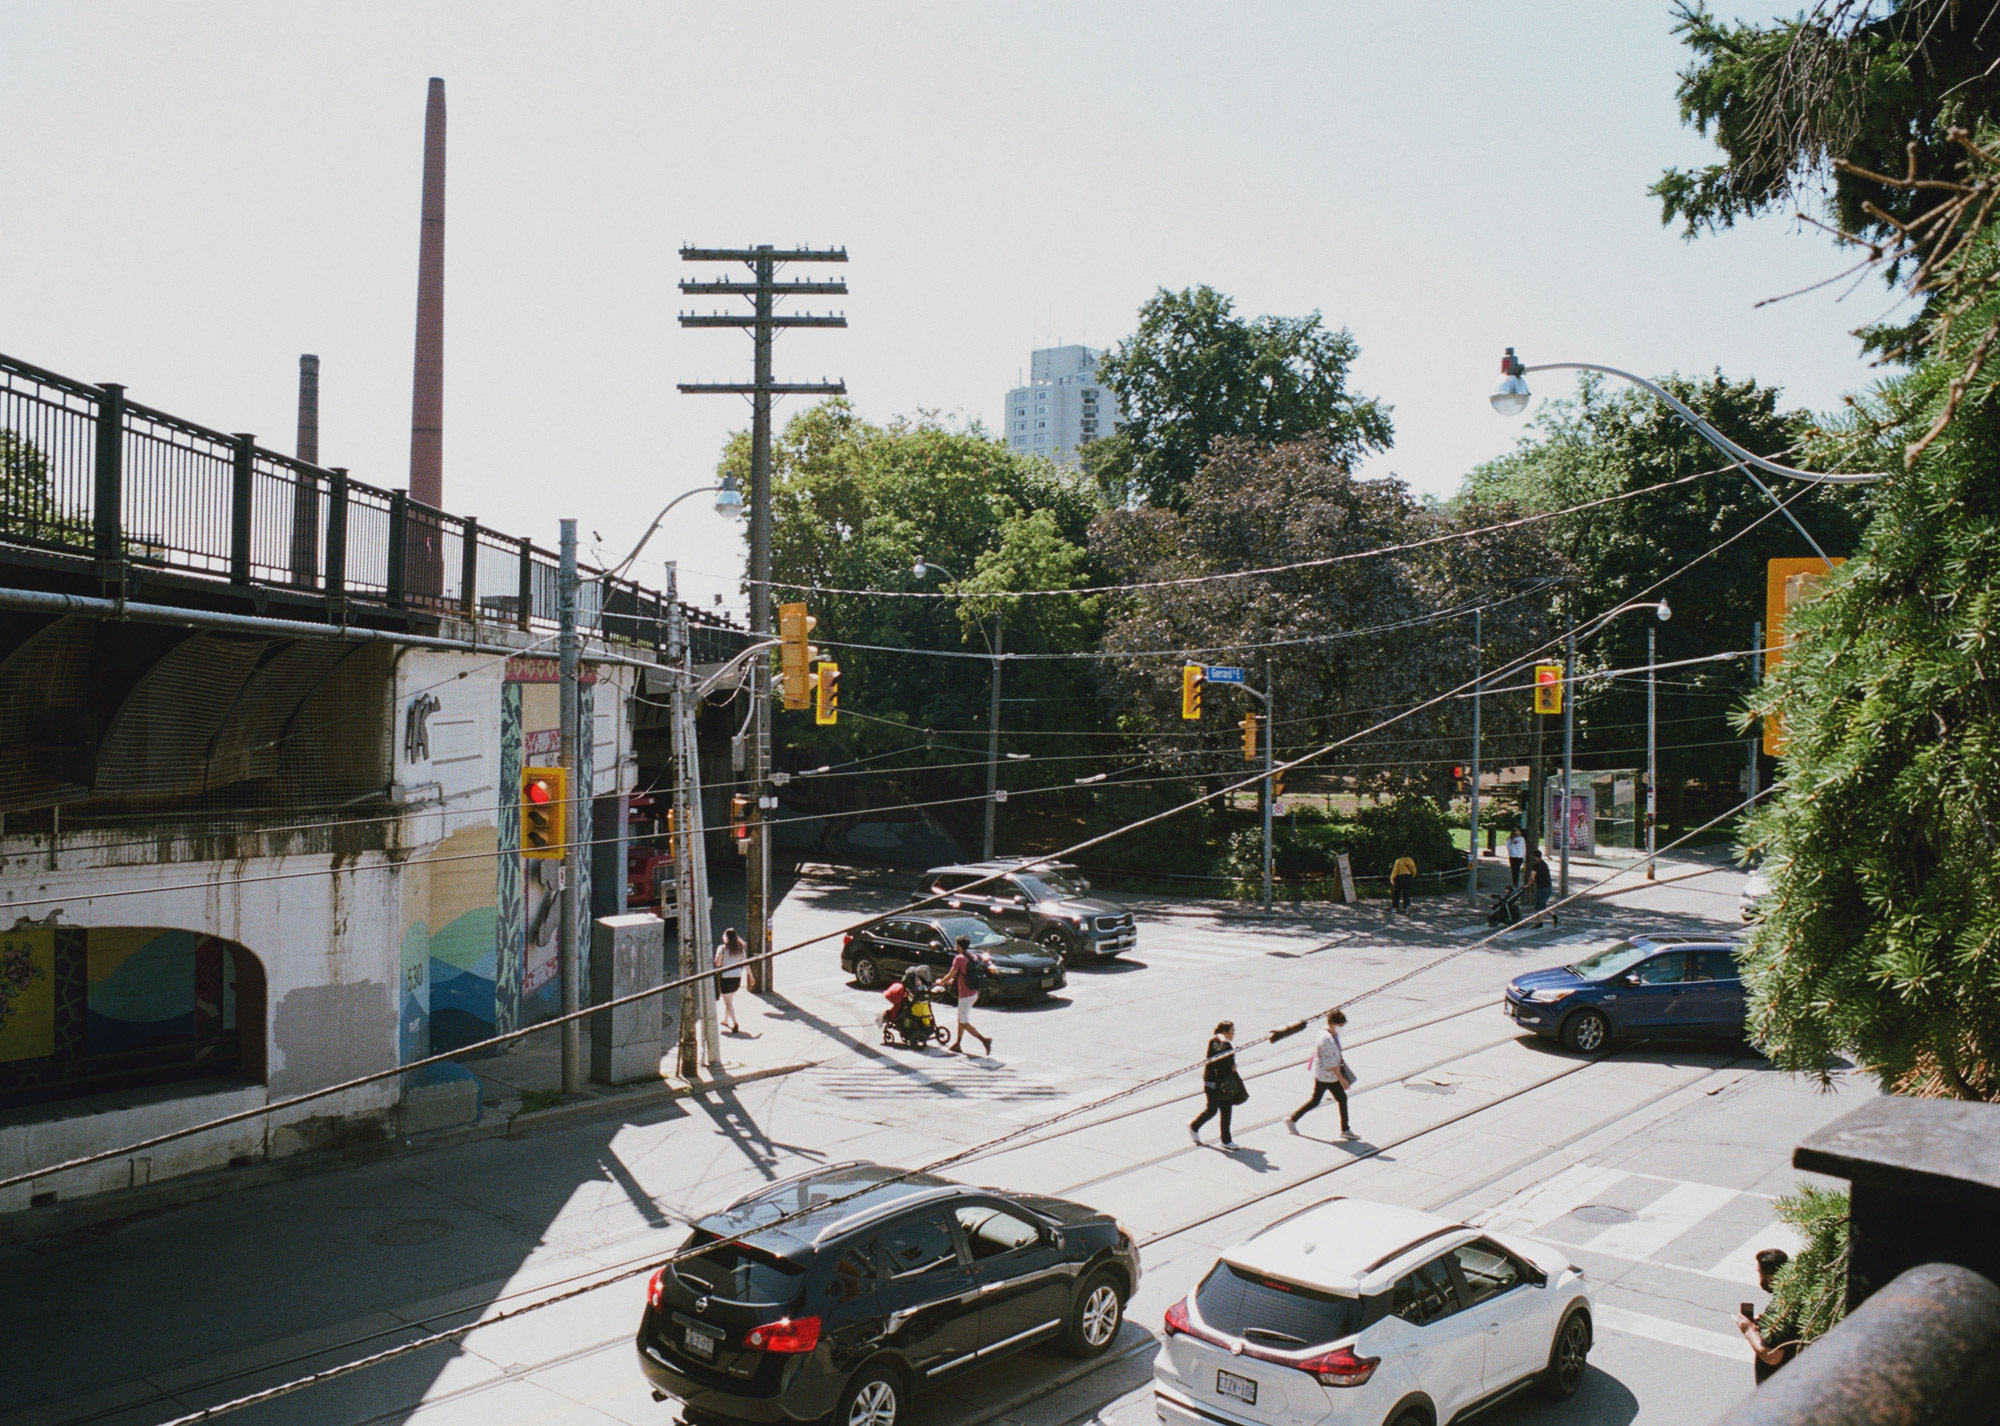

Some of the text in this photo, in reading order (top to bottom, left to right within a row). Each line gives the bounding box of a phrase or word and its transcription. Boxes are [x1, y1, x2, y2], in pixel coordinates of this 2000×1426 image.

[1211, 668, 1232, 679] Gerrard
[1236, 669, 1241, 679] E
[407, 962, 423, 992] 530
